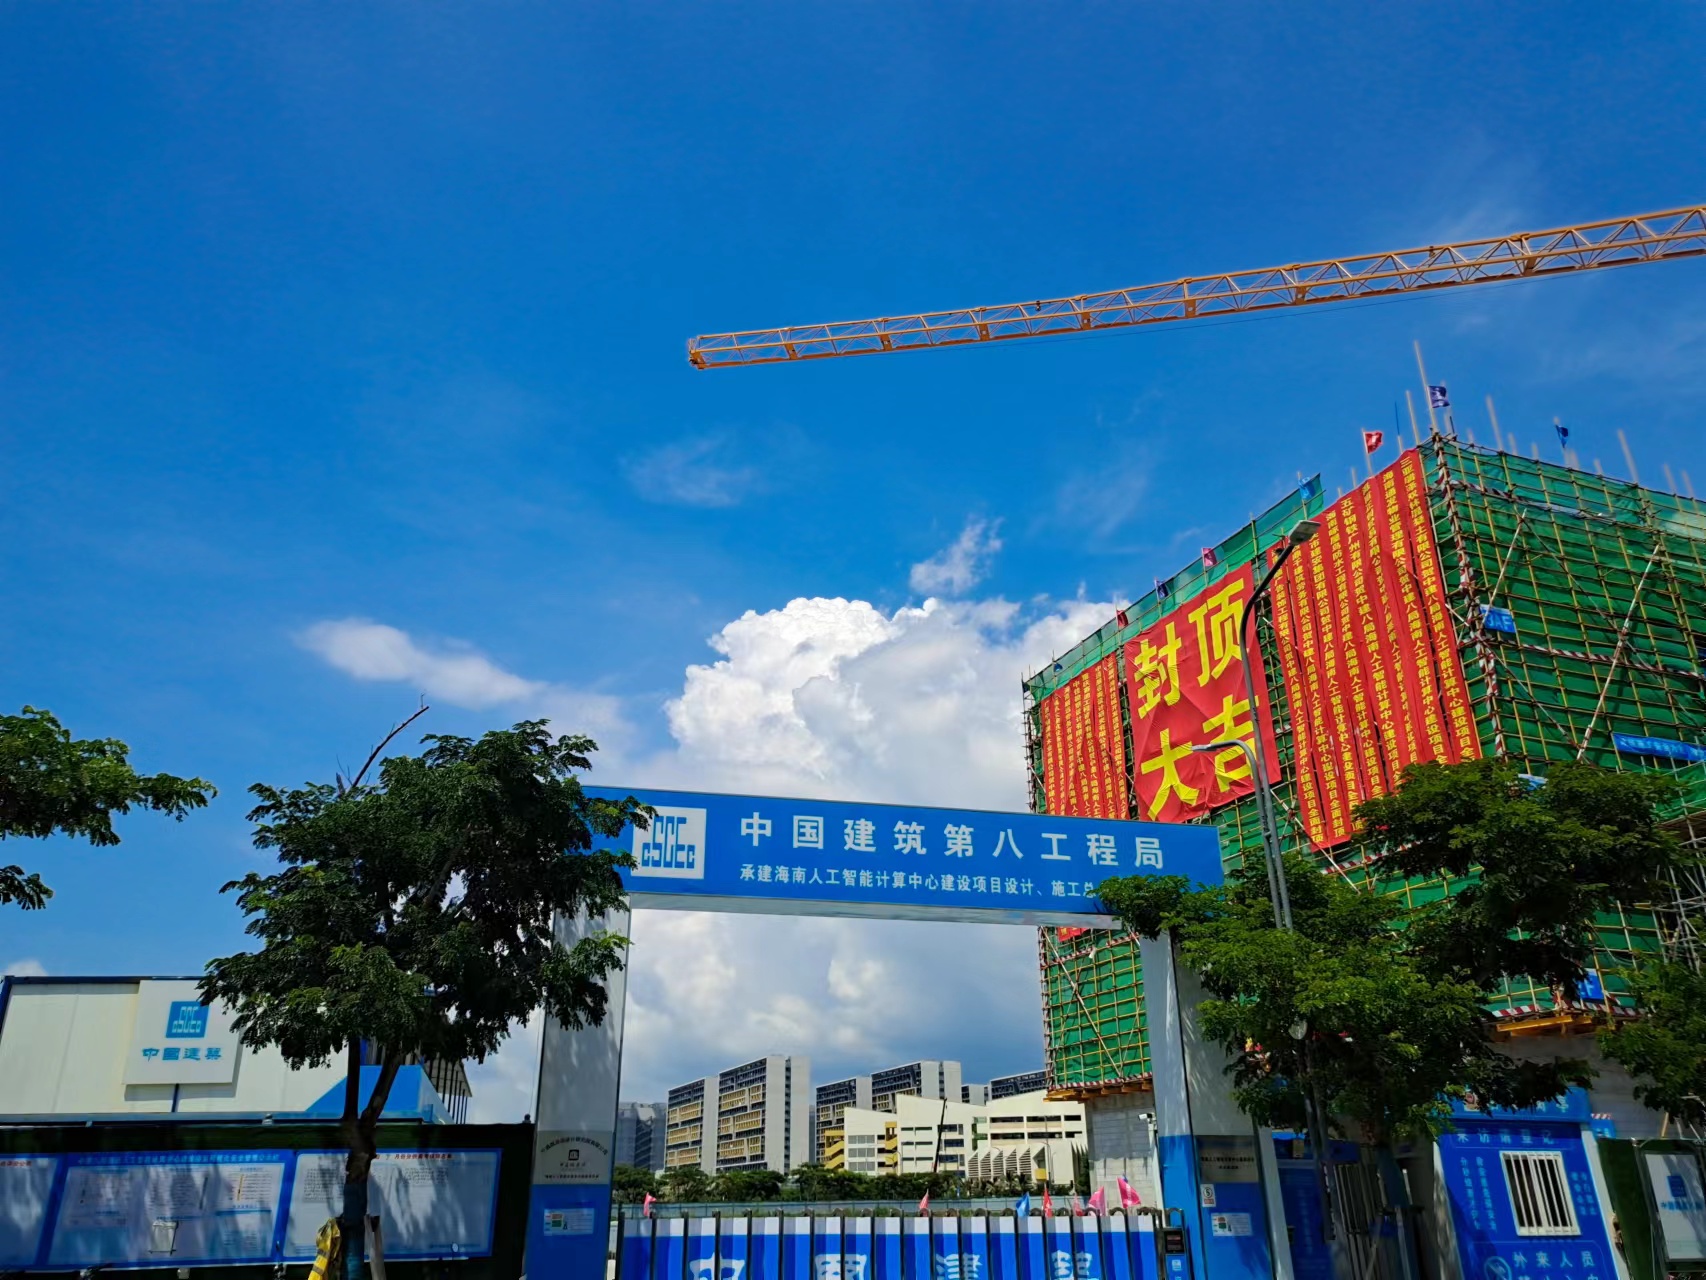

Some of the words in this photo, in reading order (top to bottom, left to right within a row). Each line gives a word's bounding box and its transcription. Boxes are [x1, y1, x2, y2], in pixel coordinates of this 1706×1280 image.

[1133, 577, 1247, 719] 封顶
[1341, 498, 1402, 785] 五矿钢铁广州有限公司贺中建八局海南人工智能计算中心建设项目全
[1141, 694, 1259, 821] 大吉
[740, 811, 1163, 869] 中国建筑第八工程局
[740, 864, 1097, 898] 承建海南人工智能计算中心建设项目设计、施工总
